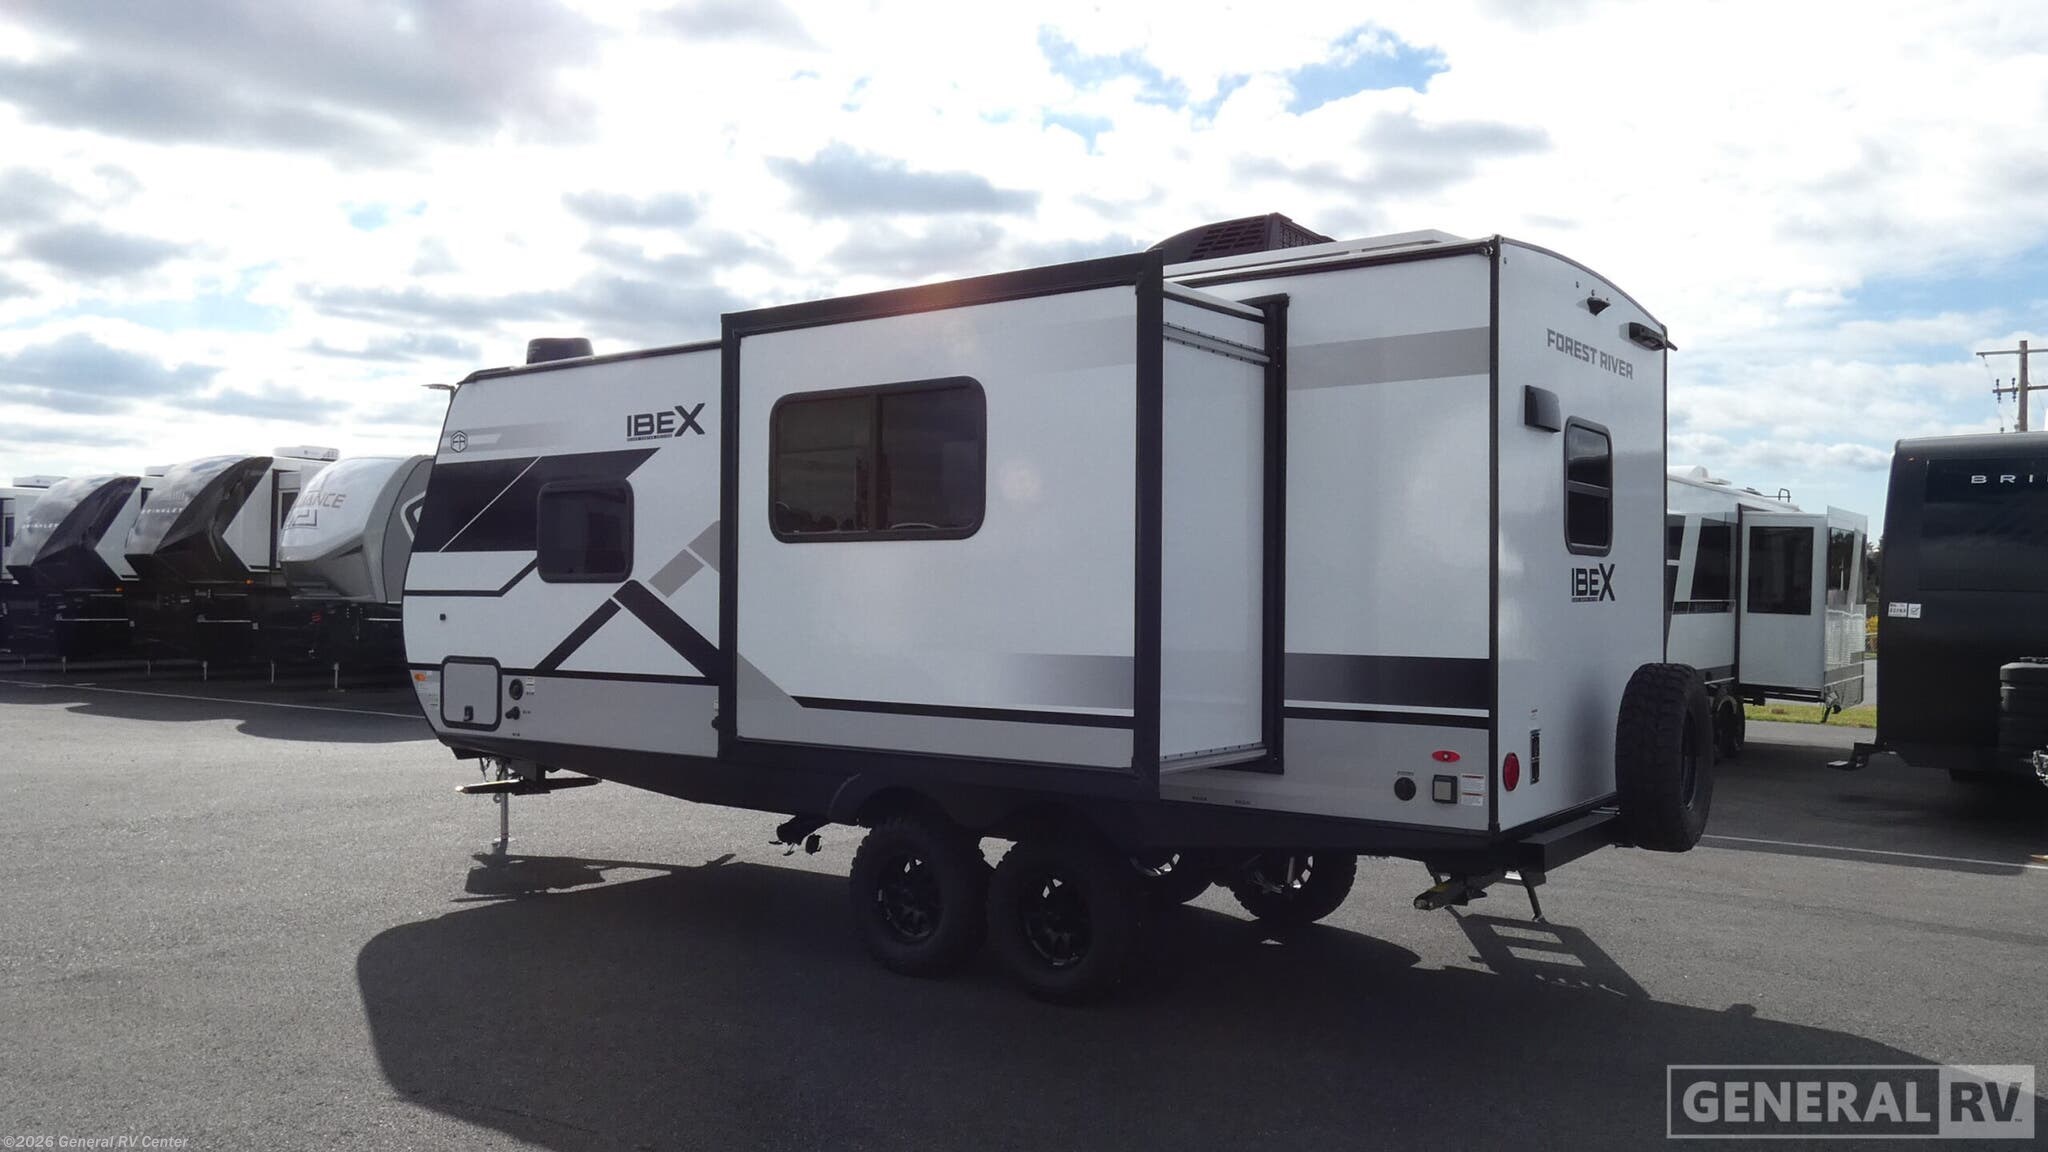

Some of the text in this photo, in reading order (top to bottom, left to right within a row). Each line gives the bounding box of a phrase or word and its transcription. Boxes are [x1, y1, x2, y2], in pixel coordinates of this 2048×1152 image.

[1546, 328, 1634, 380] FOREST RIVER
[626, 402, 706, 438] IBEX
[1970, 474, 2048, 484] BRI
[1571, 563, 1616, 602] IBEX
